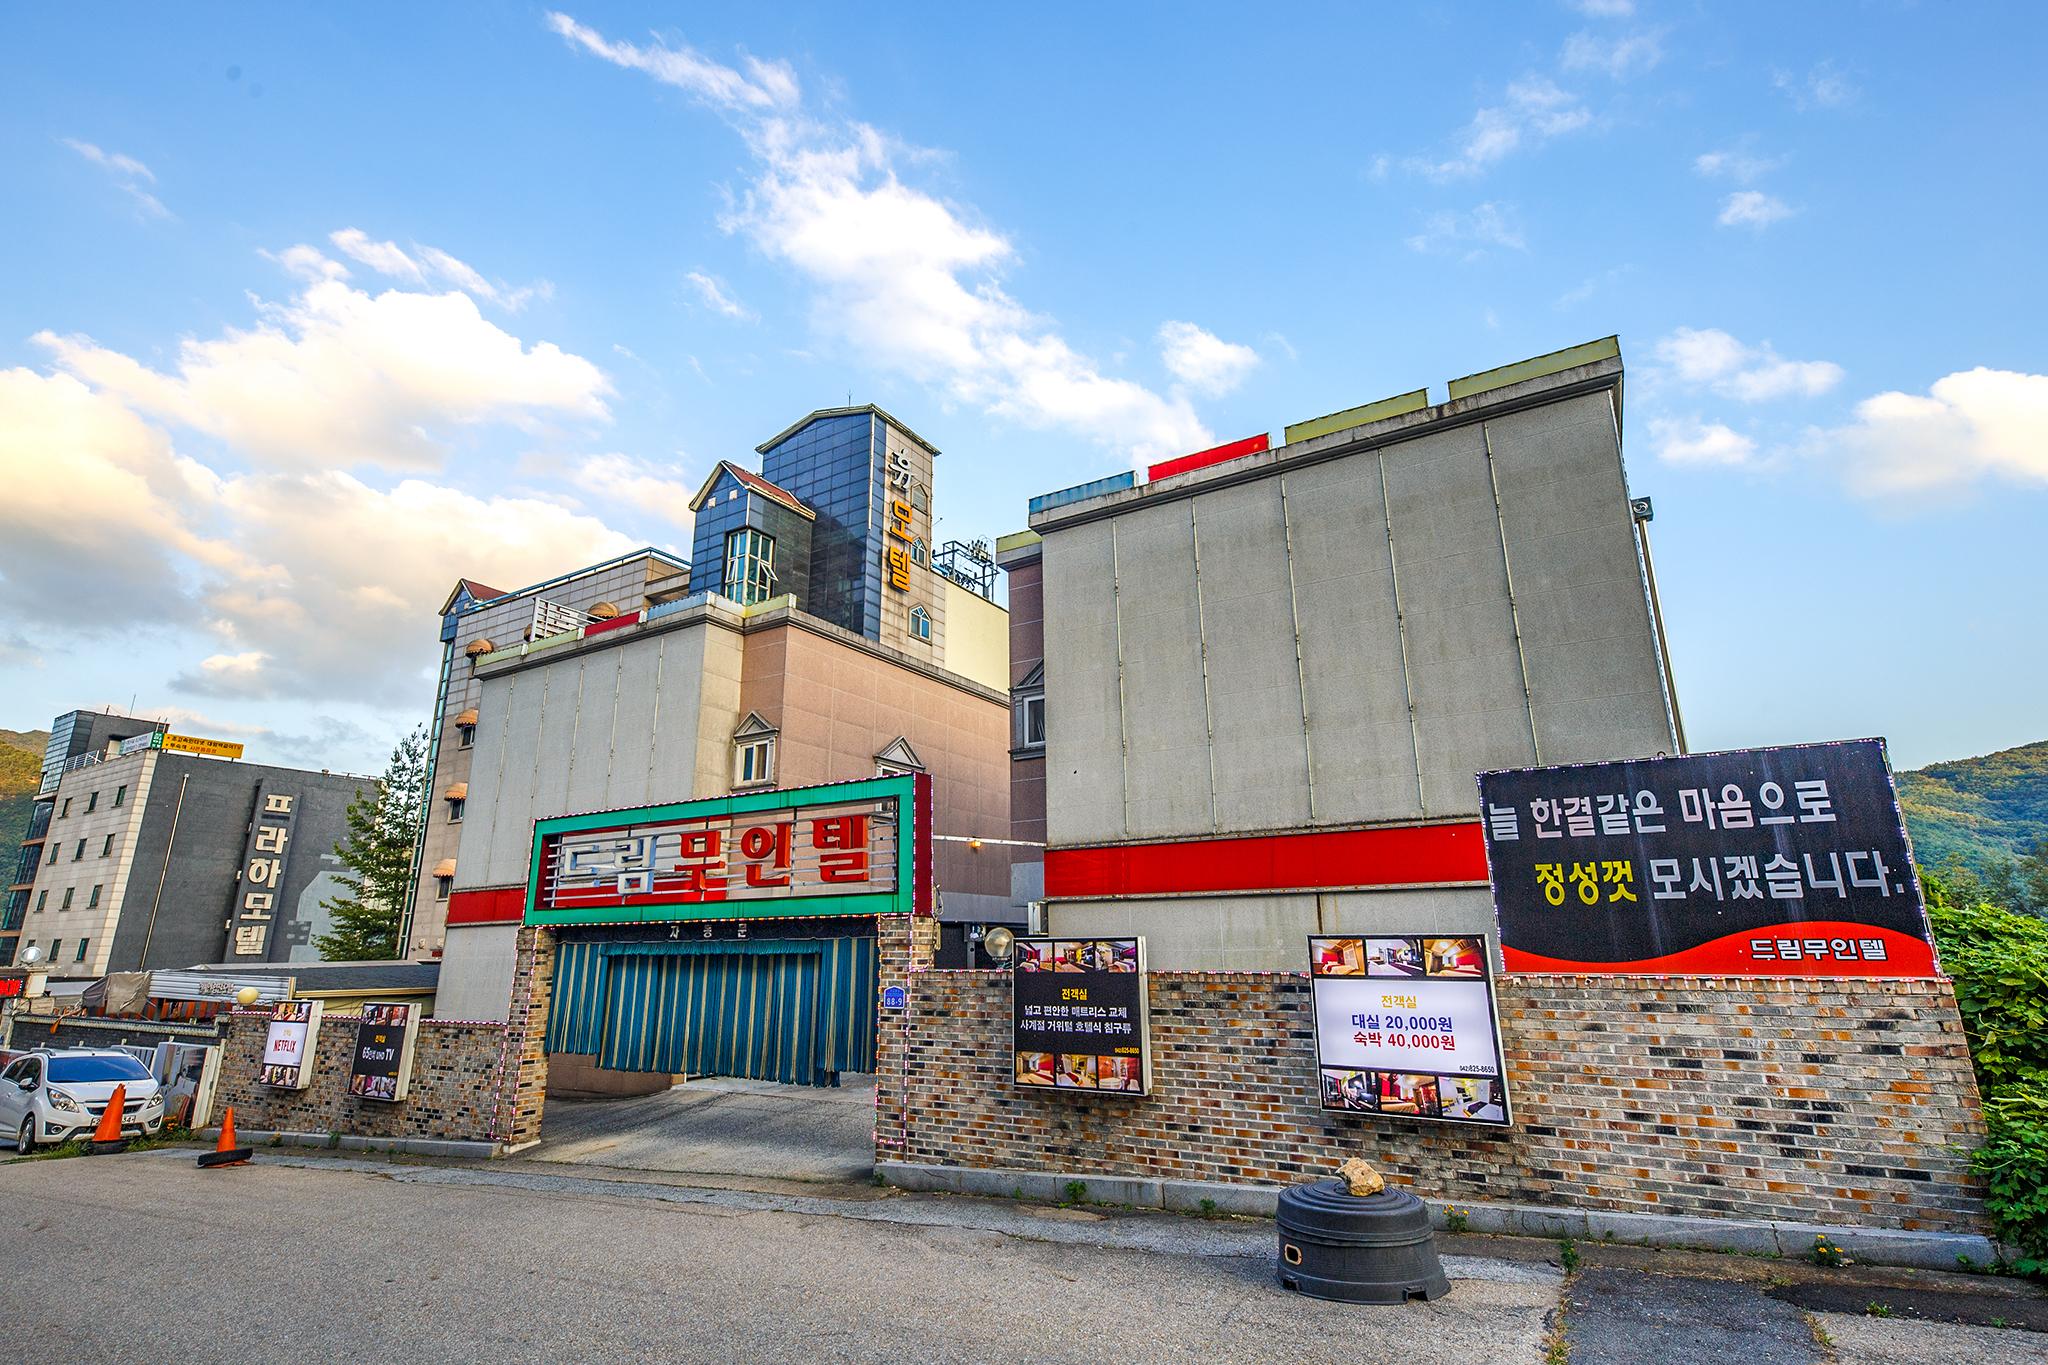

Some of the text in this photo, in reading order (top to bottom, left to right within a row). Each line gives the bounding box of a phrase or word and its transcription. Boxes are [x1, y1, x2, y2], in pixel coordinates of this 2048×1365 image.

[889, 449, 913, 592] 휴 모텔
[1489, 779, 1837, 841] 늘 한결같은 마음으로
[1535, 850, 1905, 906] 정성껏 모시겠습니다.
[1750, 938, 1888, 962] 드림무인텔
[1061, 988, 1088, 1001] 전객실
[1381, 995, 1418, 1009] 전객실
[1024, 1005, 1128, 1019] 넓고 편안한 매트리스 교체
[1019, 1019, 1046, 1032] 사계절
[1075, 1021, 1102, 1034] 호텔식
[1351, 1013, 1453, 1033] 대실 20,000원
[273, 1040, 296, 1053] NETFLIX
[1353, 1031, 1456, 1051] 숙박 40,000원
[385, 1048, 395, 1060] TV
